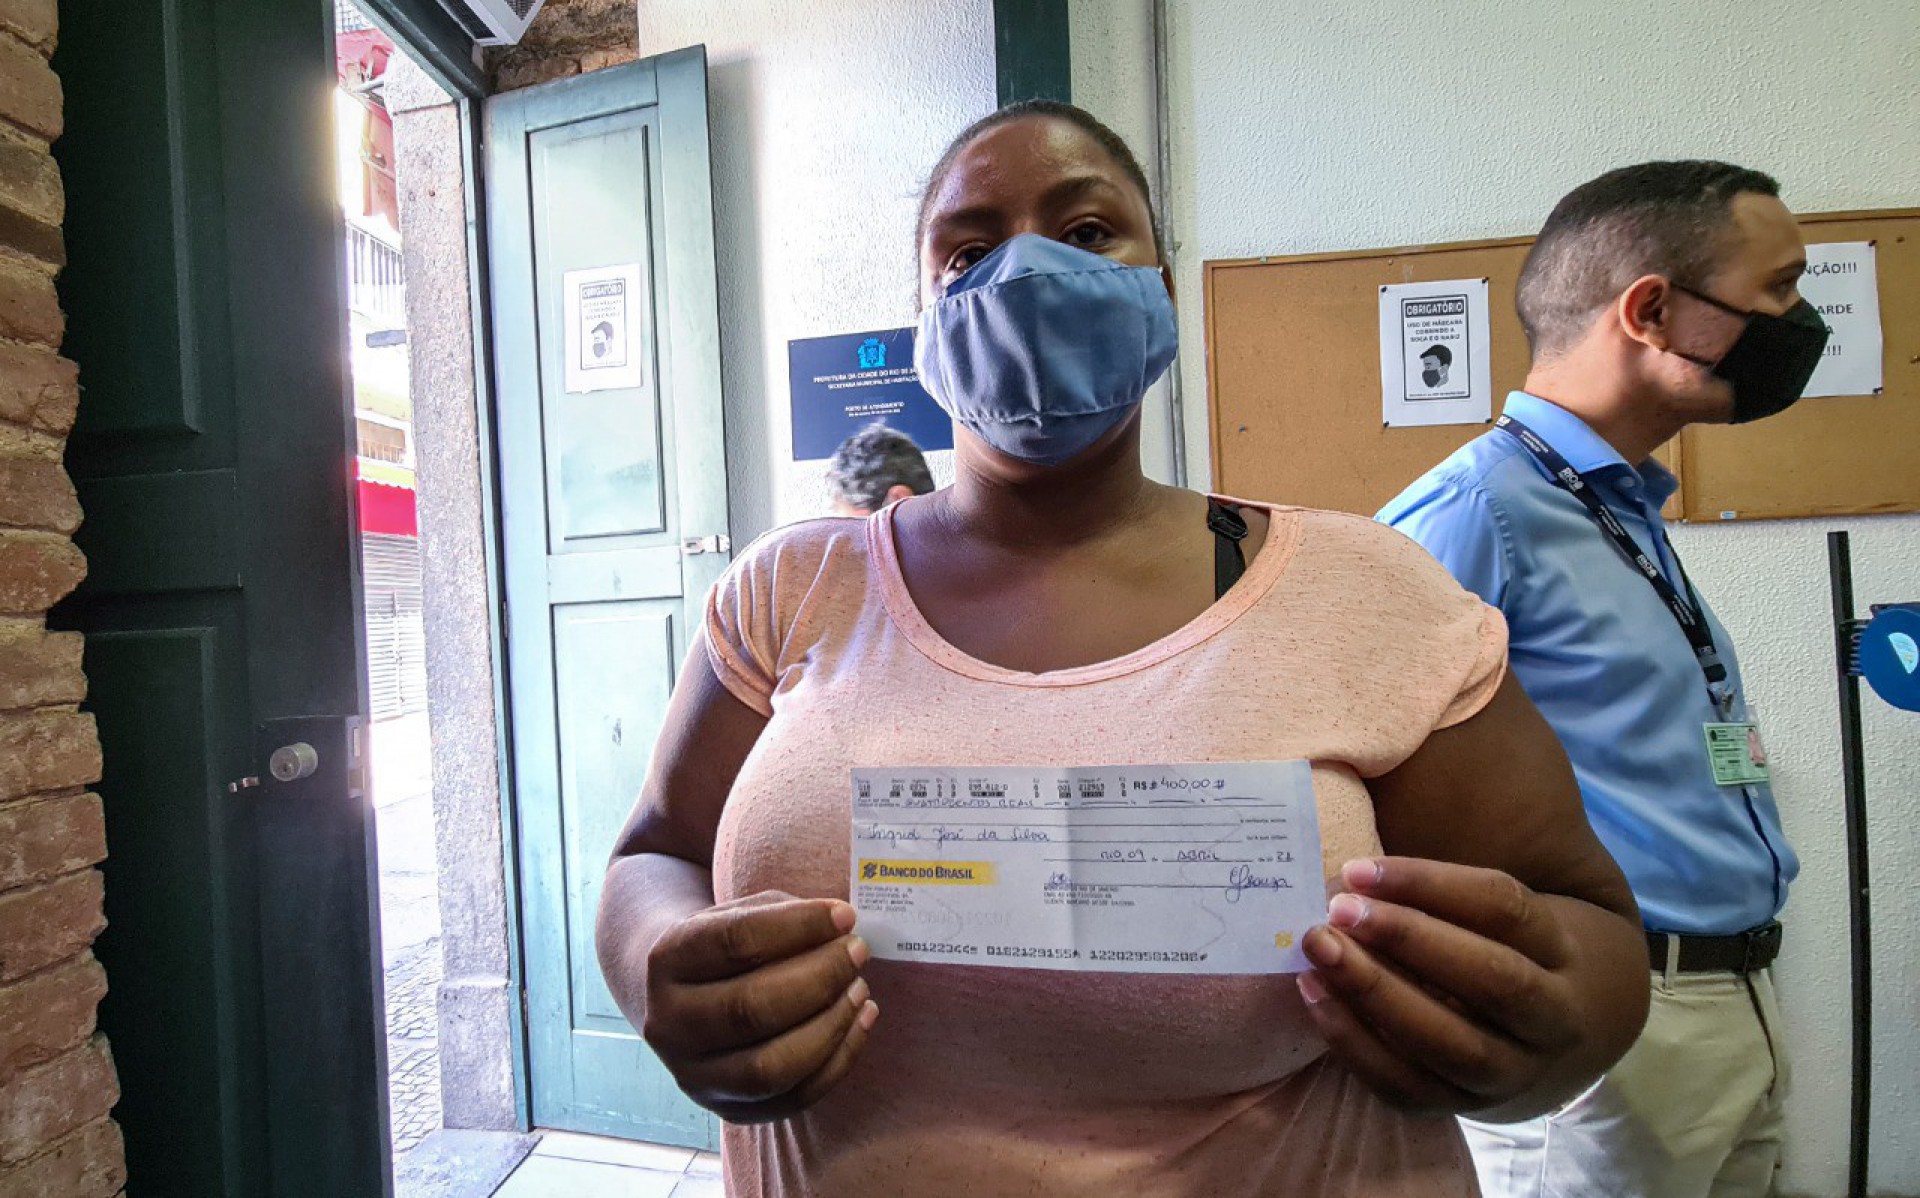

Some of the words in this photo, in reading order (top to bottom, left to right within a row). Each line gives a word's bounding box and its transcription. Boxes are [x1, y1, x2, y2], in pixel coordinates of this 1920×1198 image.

[1805, 262, 1857, 276] NÇÃO!!!
[1406, 301, 1463, 316] OBRIGATÓRIO
[1817, 304, 1853, 315] ARDE
[1133, 781, 1147, 791] R$
[977, 828, 999, 841] da
[1011, 827, 1050, 842] Silva
[880, 864, 917, 878] BANCO
[919, 867, 934, 878] DO
[935, 865, 975, 880] BRASIL
